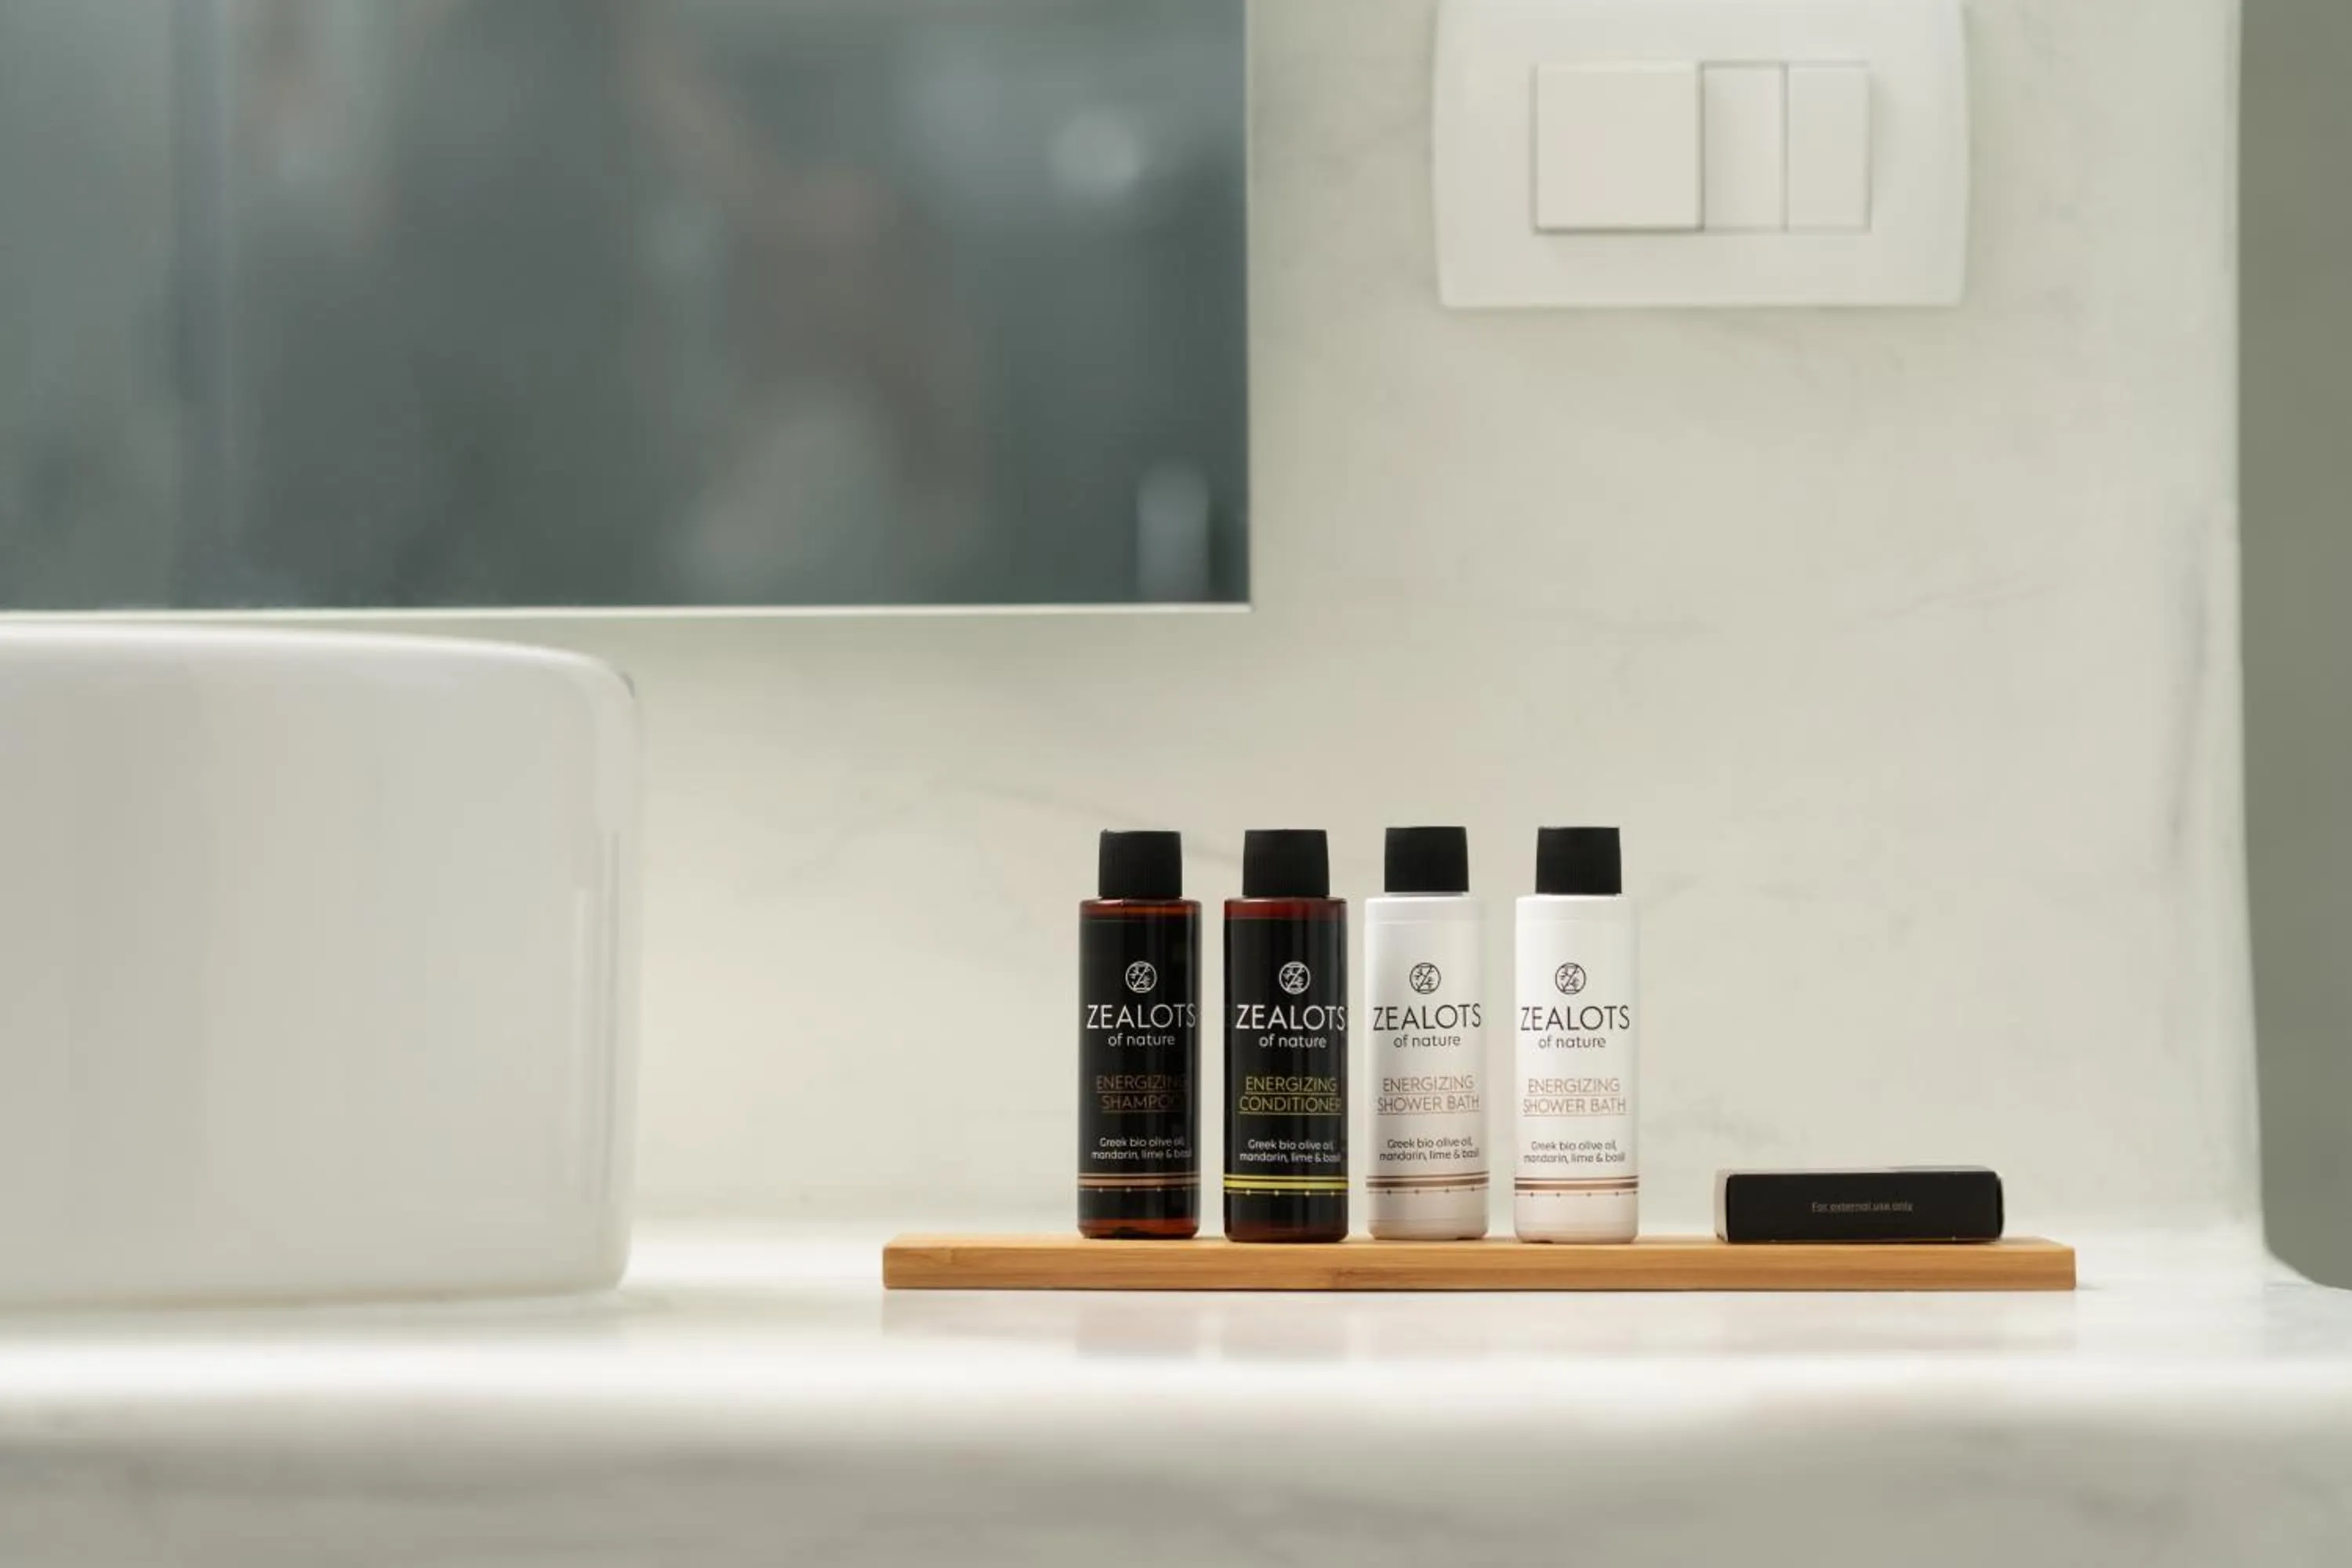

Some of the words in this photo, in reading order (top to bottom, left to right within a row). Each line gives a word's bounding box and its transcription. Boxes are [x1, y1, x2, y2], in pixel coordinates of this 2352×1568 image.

[1087, 1004, 1196, 1029] ZEALOTS
[1236, 1004, 1345, 1031] ZEALOTS
[1373, 1004, 1481, 1031] ZEALOTS
[1521, 1004, 1630, 1031] ZEALOTS
[1108, 1033, 1123, 1047] of
[1127, 1034, 1175, 1047] nature
[1259, 1033, 1276, 1047] of
[1279, 1035, 1327, 1048] nature
[1393, 1034, 1408, 1048] of
[1412, 1036, 1461, 1047] nature
[1538, 1035, 1552, 1049] of
[1556, 1036, 1606, 1048] nature
[1246, 1076, 1337, 1092] ENERGIZING
[1383, 1075, 1474, 1092] ENERGIZING
[1528, 1078, 1621, 1094] ENERGIZING
[1102, 1094, 1180, 1110] SHAMPO
[1240, 1096, 1341, 1112] CONDITIONER
[1377, 1096, 1442, 1112] SHOWER
[1447, 1094, 1479, 1111] BATH
[1523, 1098, 1585, 1113] SHOWER
[1591, 1097, 1626, 1112] BATH
[1130, 1137, 1146, 1148] bio
[1247, 1139, 1276, 1150] Greek
[1279, 1140, 1296, 1150] bio
[1298, 1140, 1321, 1151] olive
[1387, 1138, 1414, 1149] Greek
[1417, 1138, 1434, 1149] bio
[1436, 1138, 1459, 1149] olive
[1559, 1141, 1577, 1151] bio
[1166, 1149, 1172, 1159] &
[1315, 1153, 1321, 1163] &
[1429, 1149, 1451, 1160] lime
[1453, 1149, 1460, 1160] &
[1596, 1152, 1603, 1163] &
